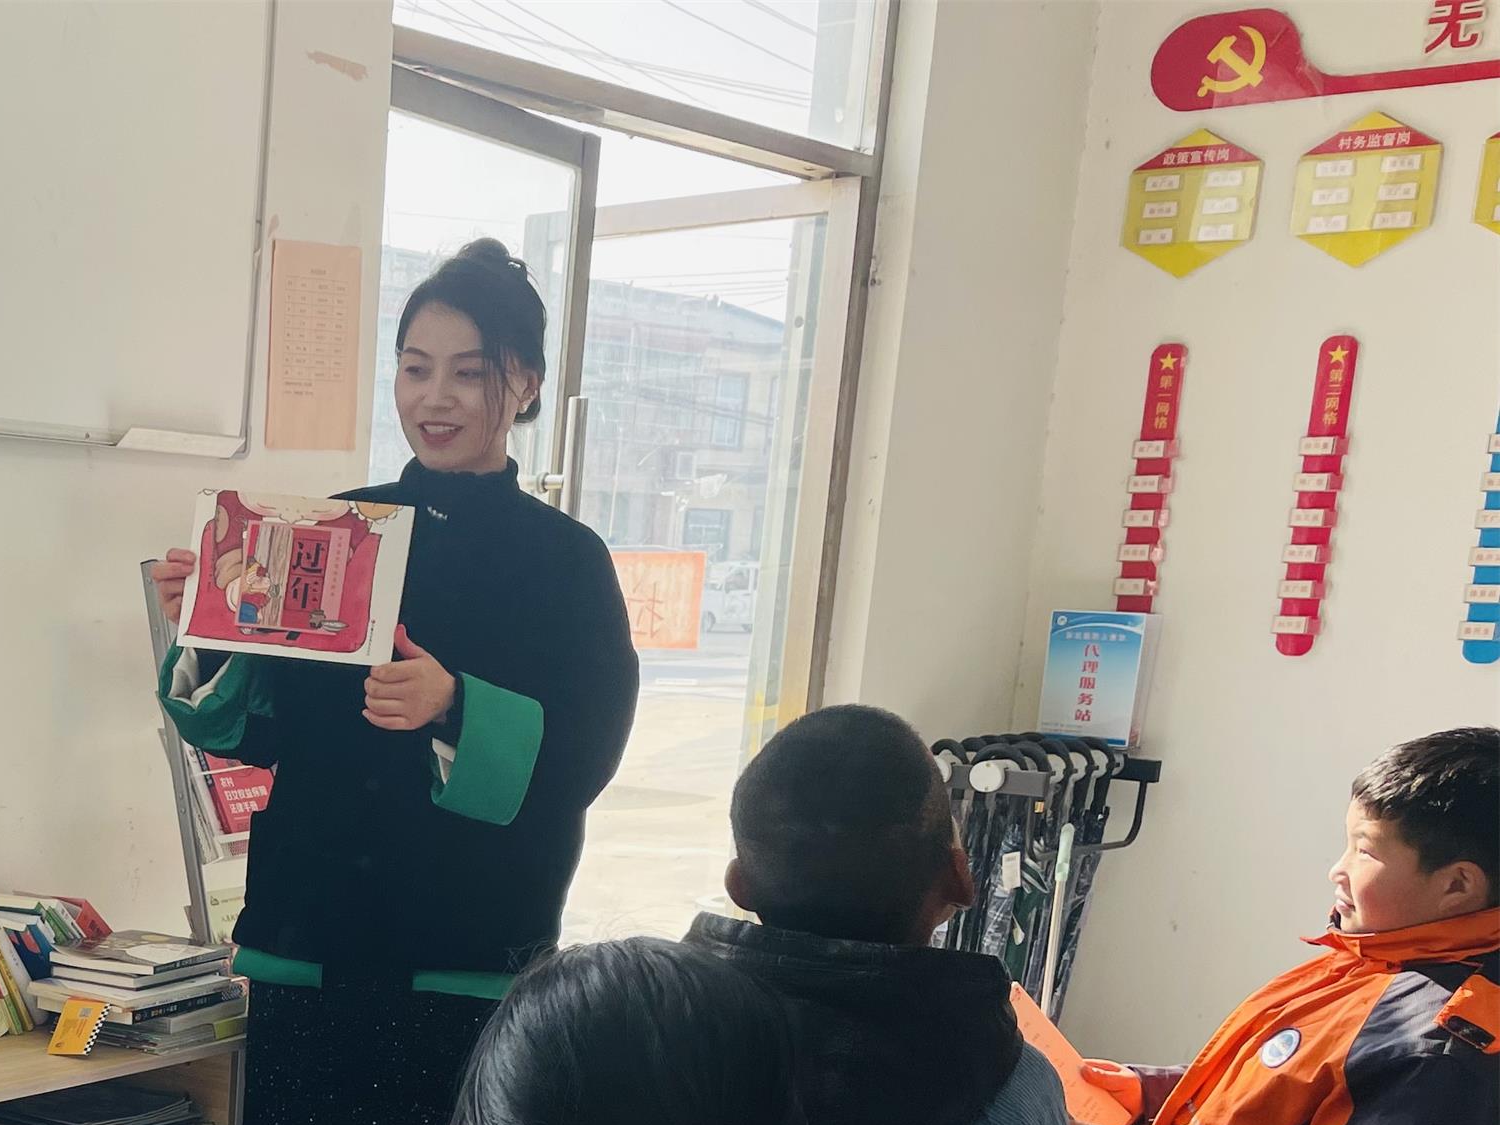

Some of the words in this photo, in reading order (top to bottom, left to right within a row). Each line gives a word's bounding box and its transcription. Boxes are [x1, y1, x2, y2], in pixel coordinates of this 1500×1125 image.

[1162, 147, 1230, 166] 政策宣传岗
[1338, 131, 1411, 149] 村务监督岗
[1154, 375, 1173, 429] 第一网格
[1322, 369, 1344, 425] 第二网格
[1074, 643, 1100, 721] 代理服务站
